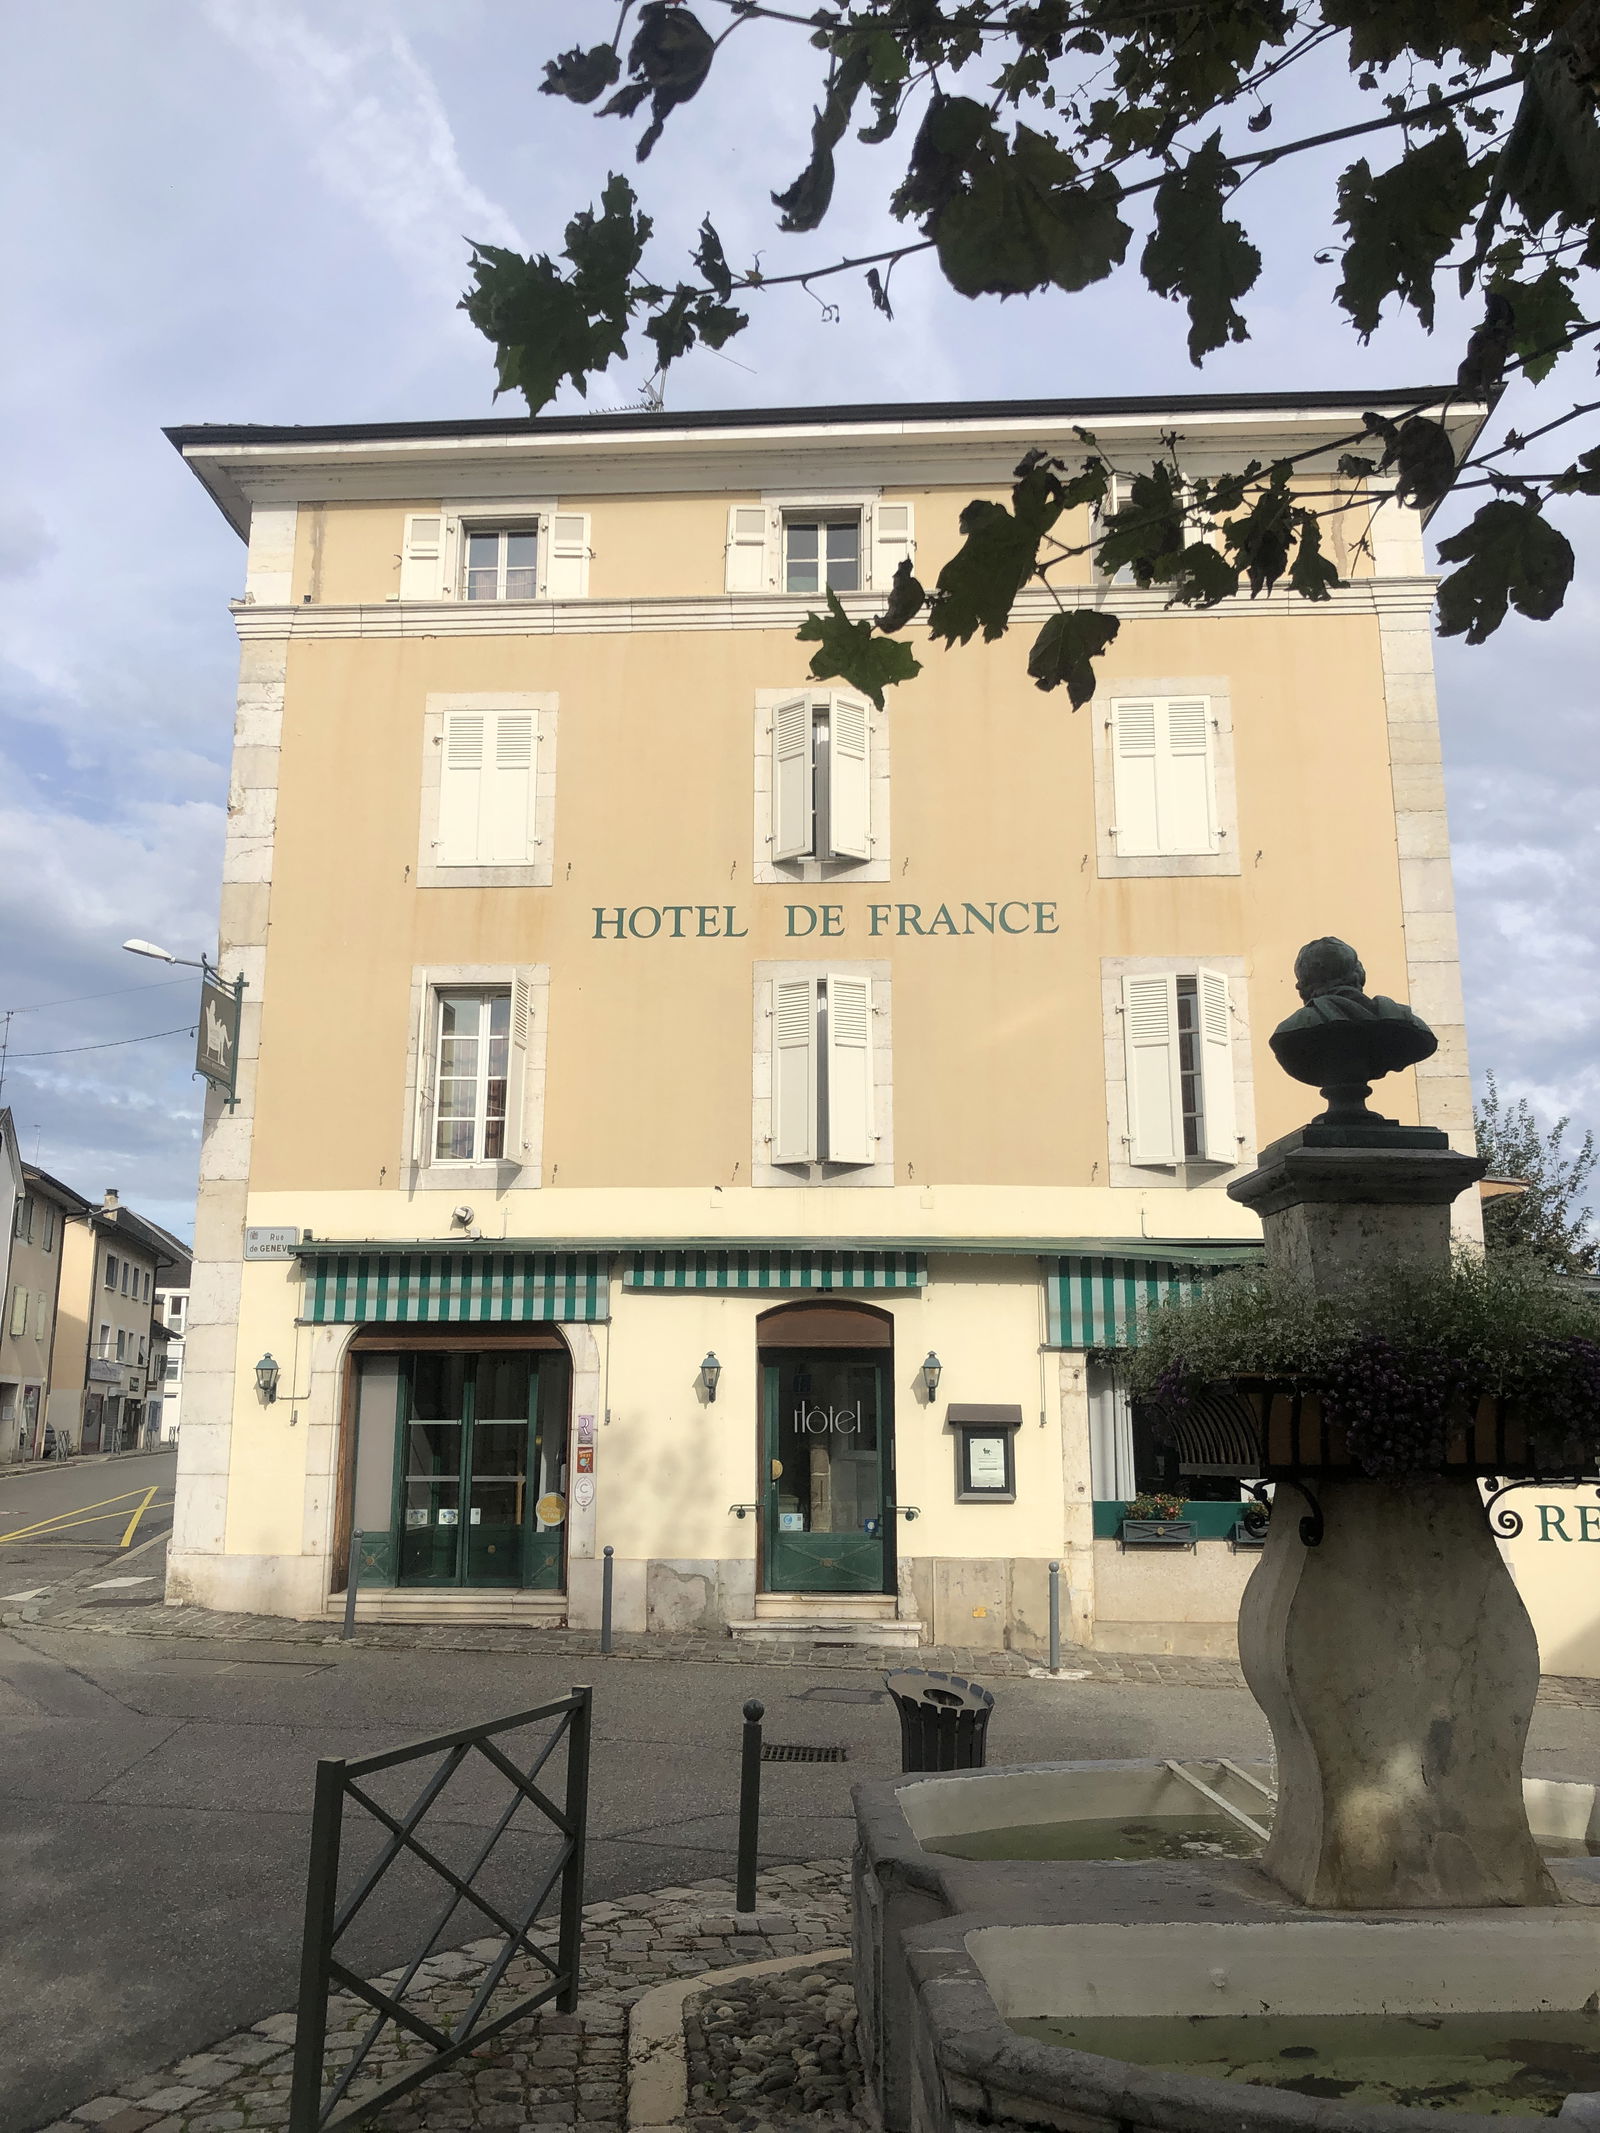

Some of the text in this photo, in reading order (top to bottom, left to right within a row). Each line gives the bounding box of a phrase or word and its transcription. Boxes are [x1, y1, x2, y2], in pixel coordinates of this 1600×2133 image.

[591, 901, 1060, 940] HOTEL DE FRANCE
[270, 1233, 284, 1241] Rue
[259, 1244, 290, 1252] GENEV
